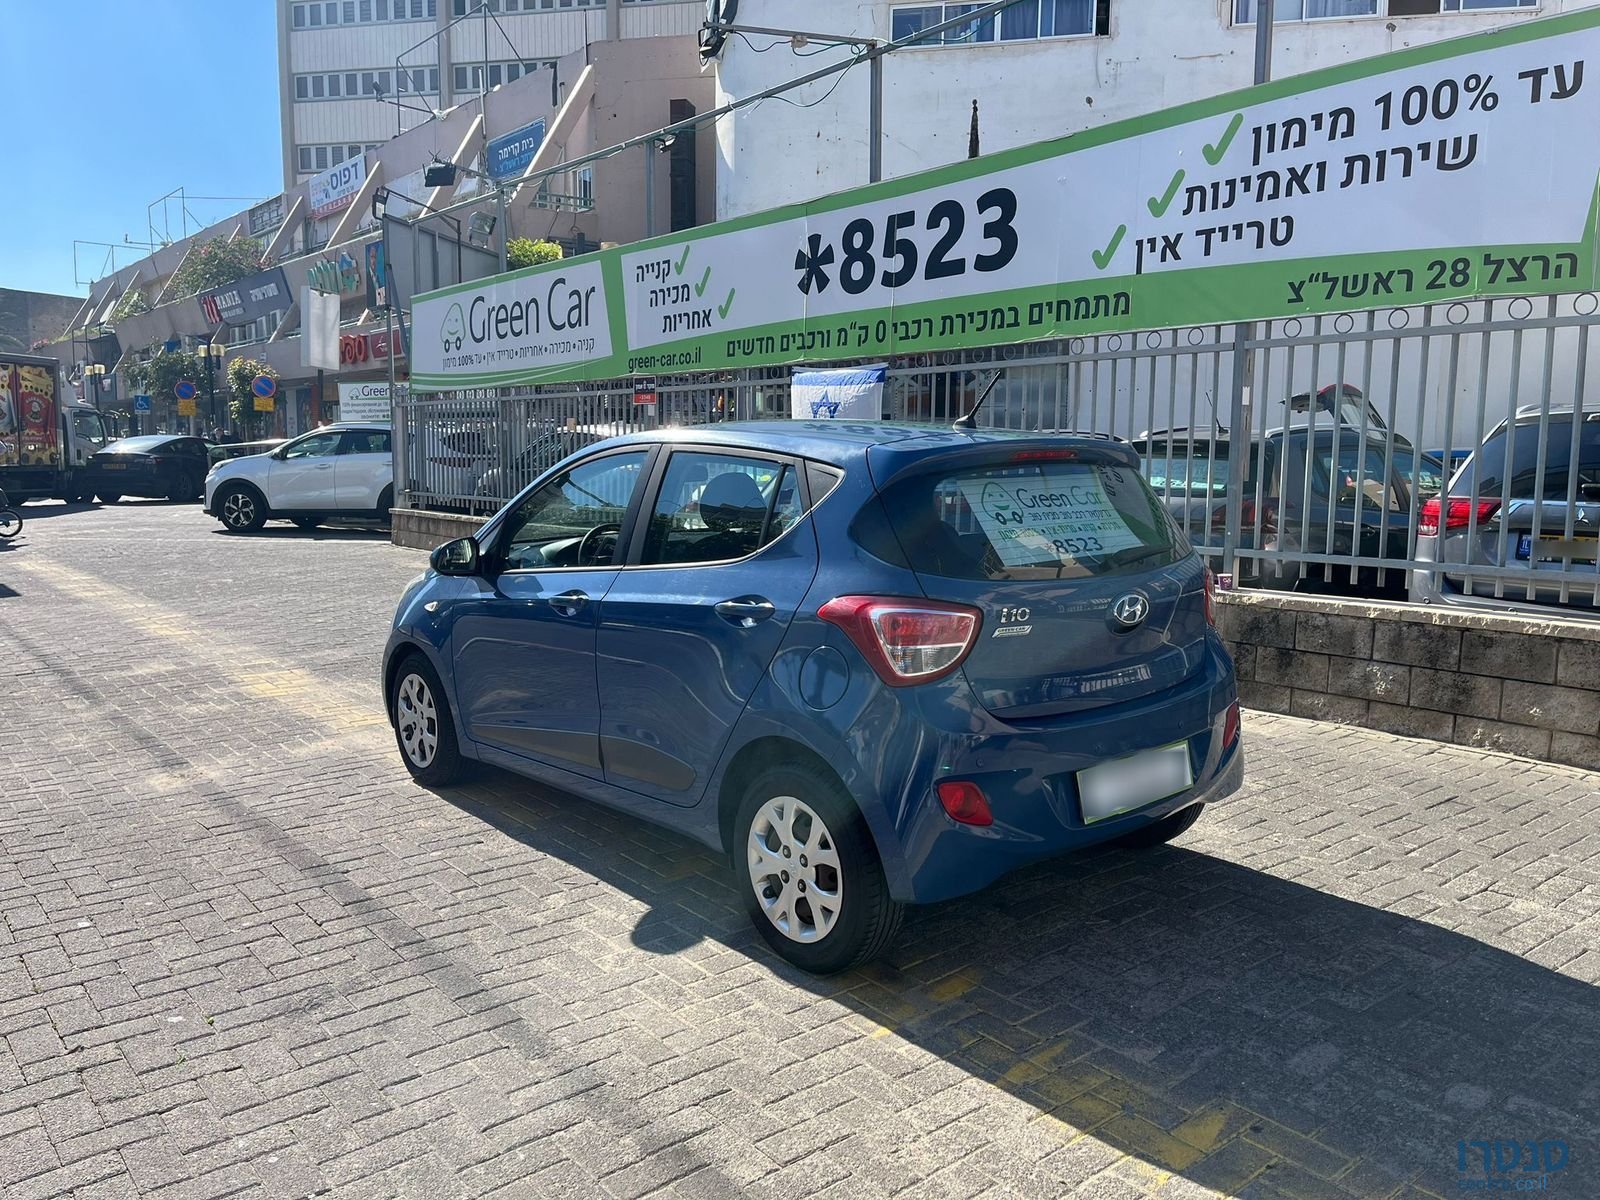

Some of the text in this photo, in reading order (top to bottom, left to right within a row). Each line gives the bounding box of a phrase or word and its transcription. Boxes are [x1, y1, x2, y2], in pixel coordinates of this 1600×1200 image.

[1252, 60, 1585, 166] עד 100% מימון
[498, 142, 520, 160] קדימה
[521, 137, 534, 152] בית
[330, 162, 358, 190] דפוס
[1182, 133, 1478, 216] שירות ואמינות
[1135, 215, 1294, 275] טרייד אין
[636, 259, 671, 284] קנייה
[1426, 258, 1471, 291] 28
[1482, 252, 1578, 285] הרצל
[649, 284, 690, 308] מכירה
[1029, 292, 1130, 324] מתמחים
[469, 277, 596, 344] Green Car
[662, 308, 713, 334] אחריות
[940, 304, 1020, 335] במכירת
[780, 328, 830, 352] ורכבים
[875, 319, 886, 343] 0
[898, 314, 934, 342] רכבי
[442, 338, 594, 371] קניה מכירה אחריות טרייד אין עד 100% מימון
[727, 333, 776, 358] חדשים
[628, 346, 702, 374] green-car.co.il
[1016, 485, 1104, 508] Green Car
[1000, 608, 1030, 623] i10
